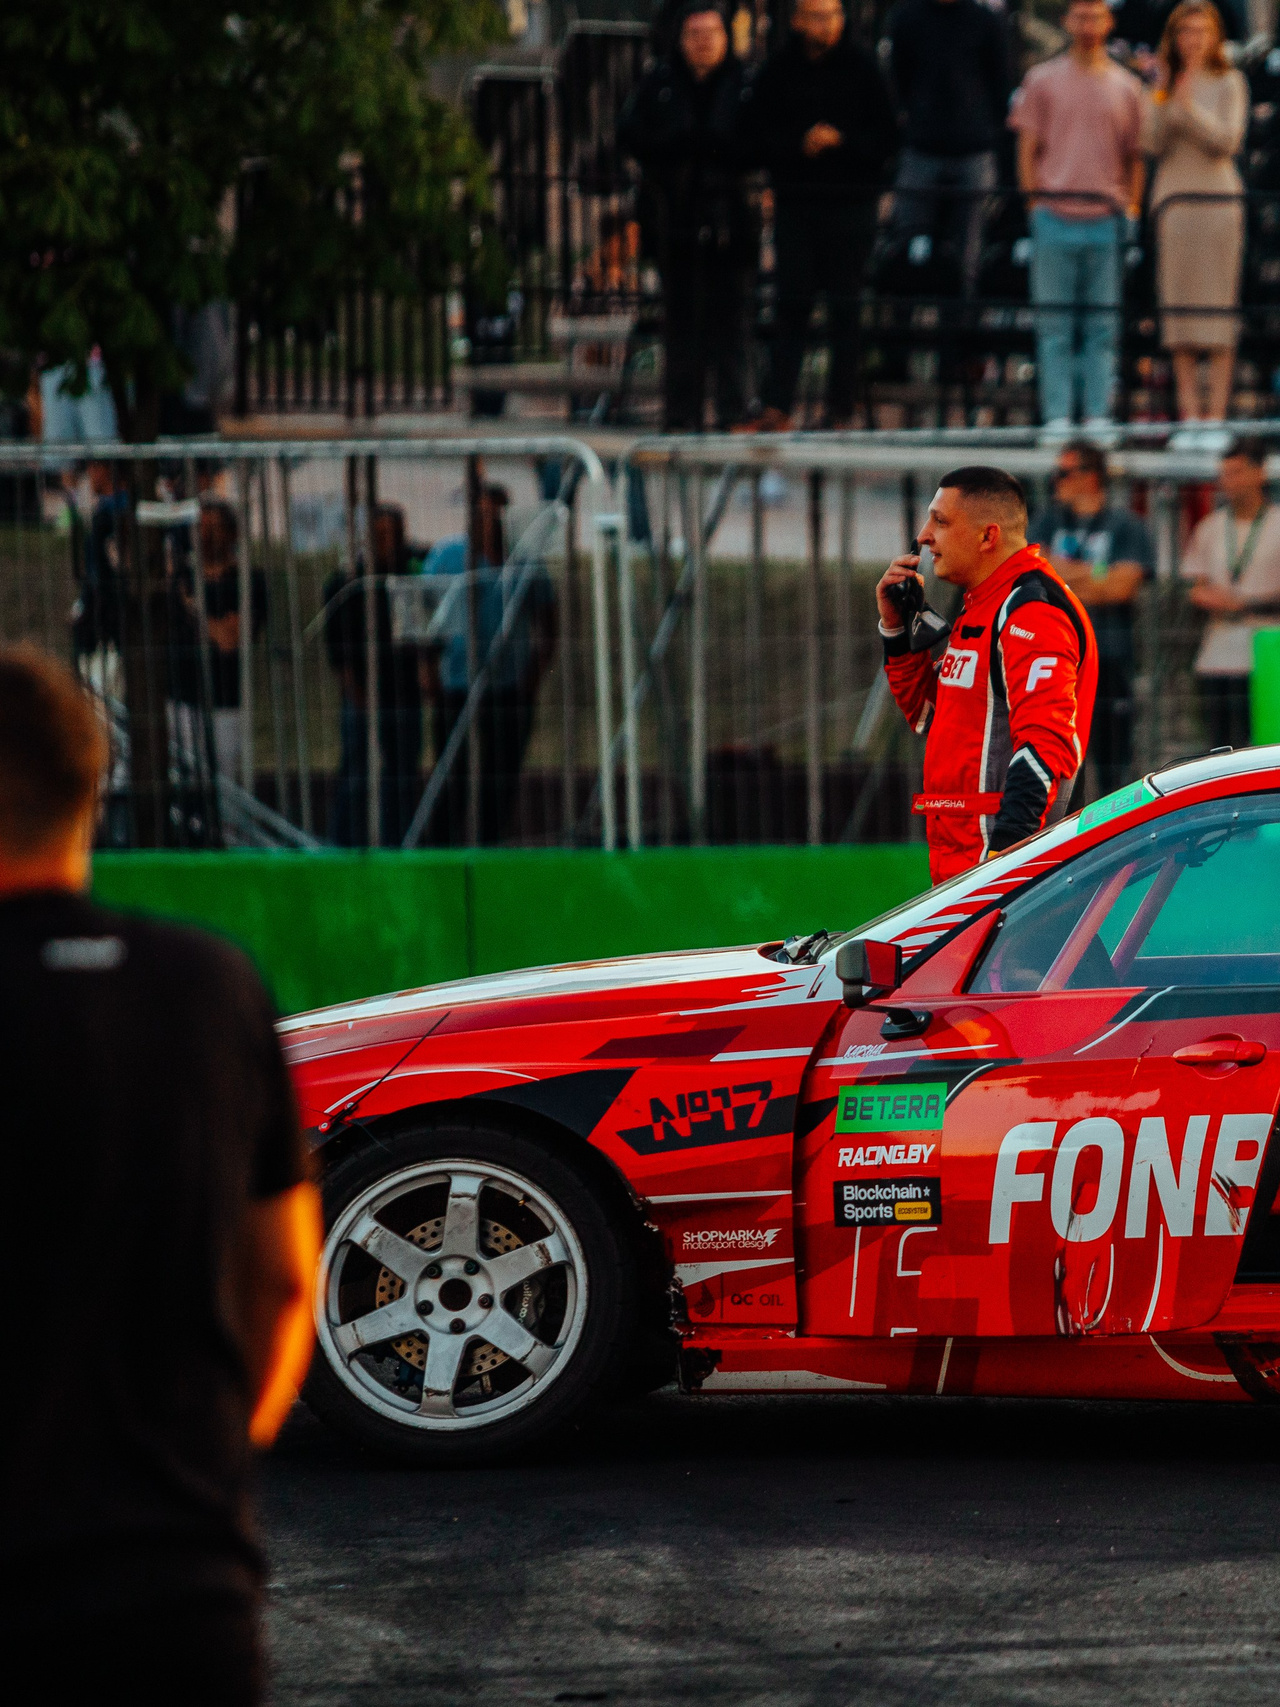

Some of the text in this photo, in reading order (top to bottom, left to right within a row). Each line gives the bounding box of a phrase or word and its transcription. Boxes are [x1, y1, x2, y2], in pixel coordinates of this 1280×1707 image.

[1025, 657, 1058, 692] F
[838, 1144, 936, 1168] RACING.BY
[843, 1183, 922, 1201] Blockchain
[843, 1203, 893, 1222] Sports
[682, 1229, 764, 1243] SHOPMARKA
[682, 1239, 736, 1251] motorsport
[730, 1293, 784, 1307] QC OIL
